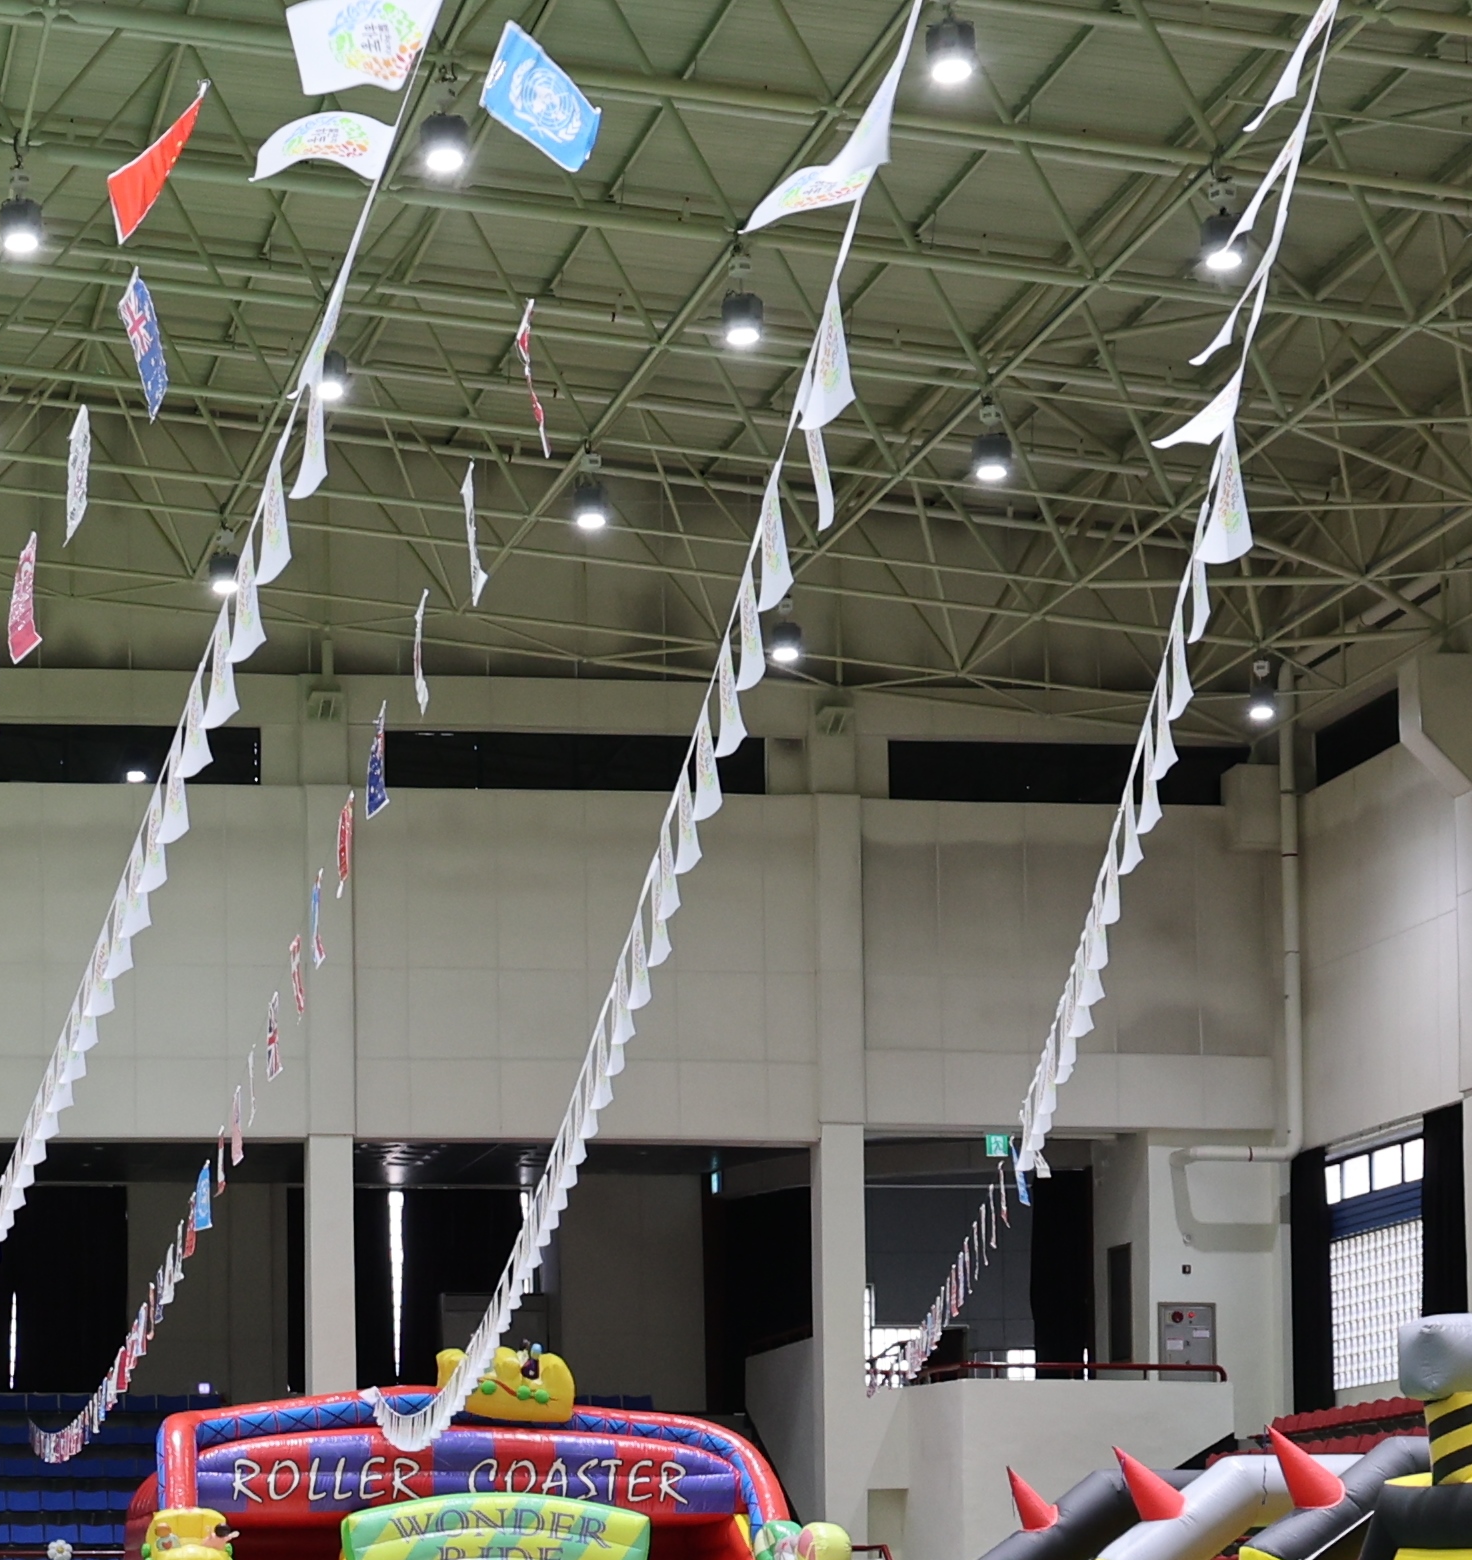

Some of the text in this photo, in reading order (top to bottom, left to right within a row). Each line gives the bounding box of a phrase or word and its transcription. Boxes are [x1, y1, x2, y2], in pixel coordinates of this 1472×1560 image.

[232, 1457, 689, 1505] ROLLER COASTER
[389, 1508, 611, 1549] WONDER
